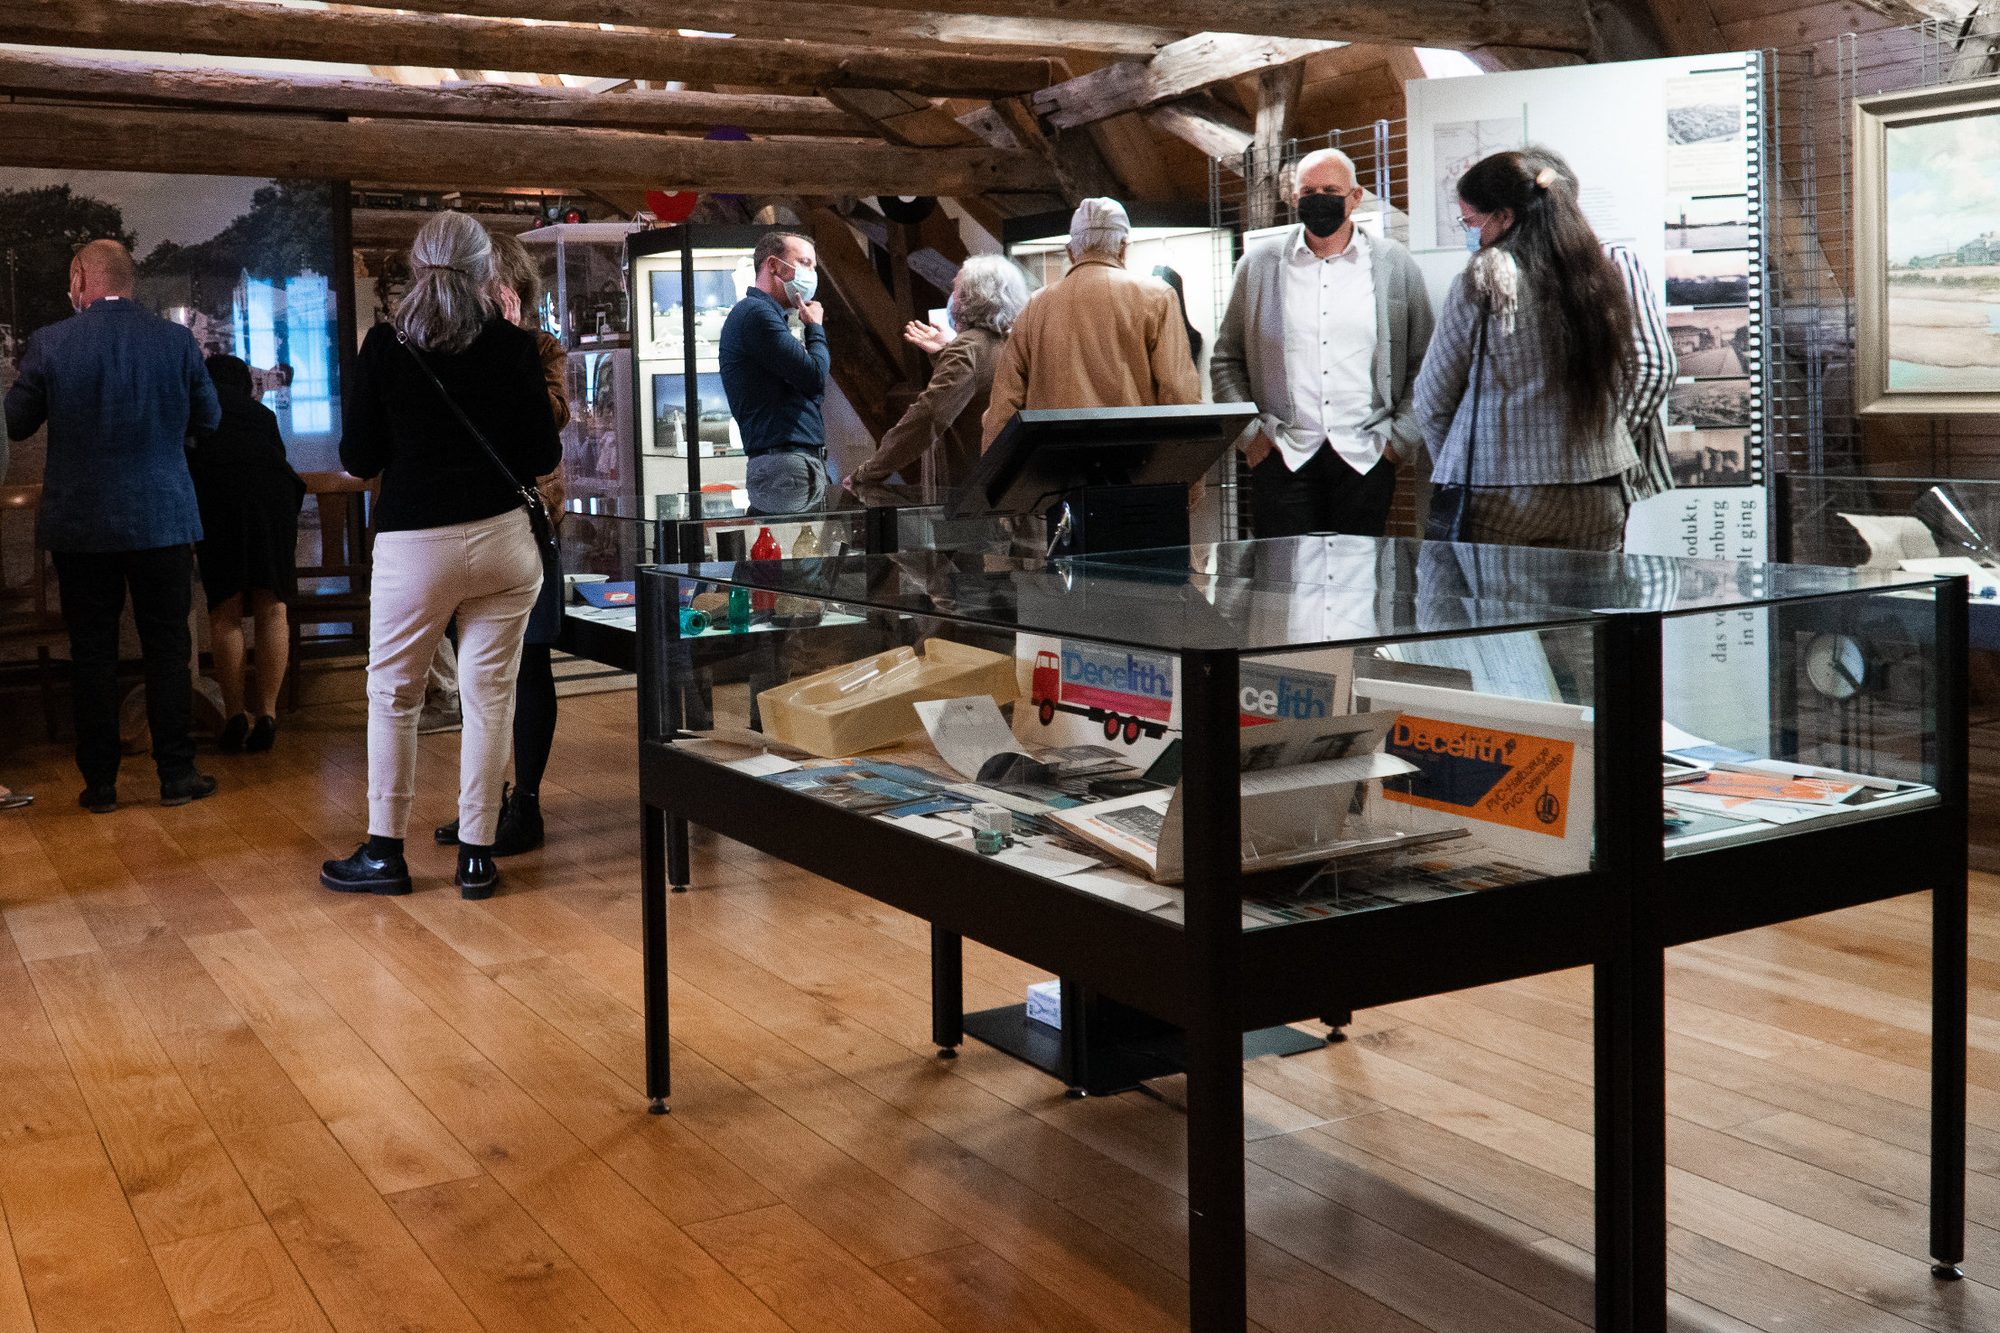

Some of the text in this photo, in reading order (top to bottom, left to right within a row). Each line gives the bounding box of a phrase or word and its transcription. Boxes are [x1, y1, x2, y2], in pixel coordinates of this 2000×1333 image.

[1682, 498, 1700, 557] odukt,
[1709, 500, 1729, 561] enburg
[1737, 500, 1757, 540] ging
[1711, 633, 1727, 663] das
[1738, 629, 1754, 646] in
[1239, 675, 1327, 721] celith
